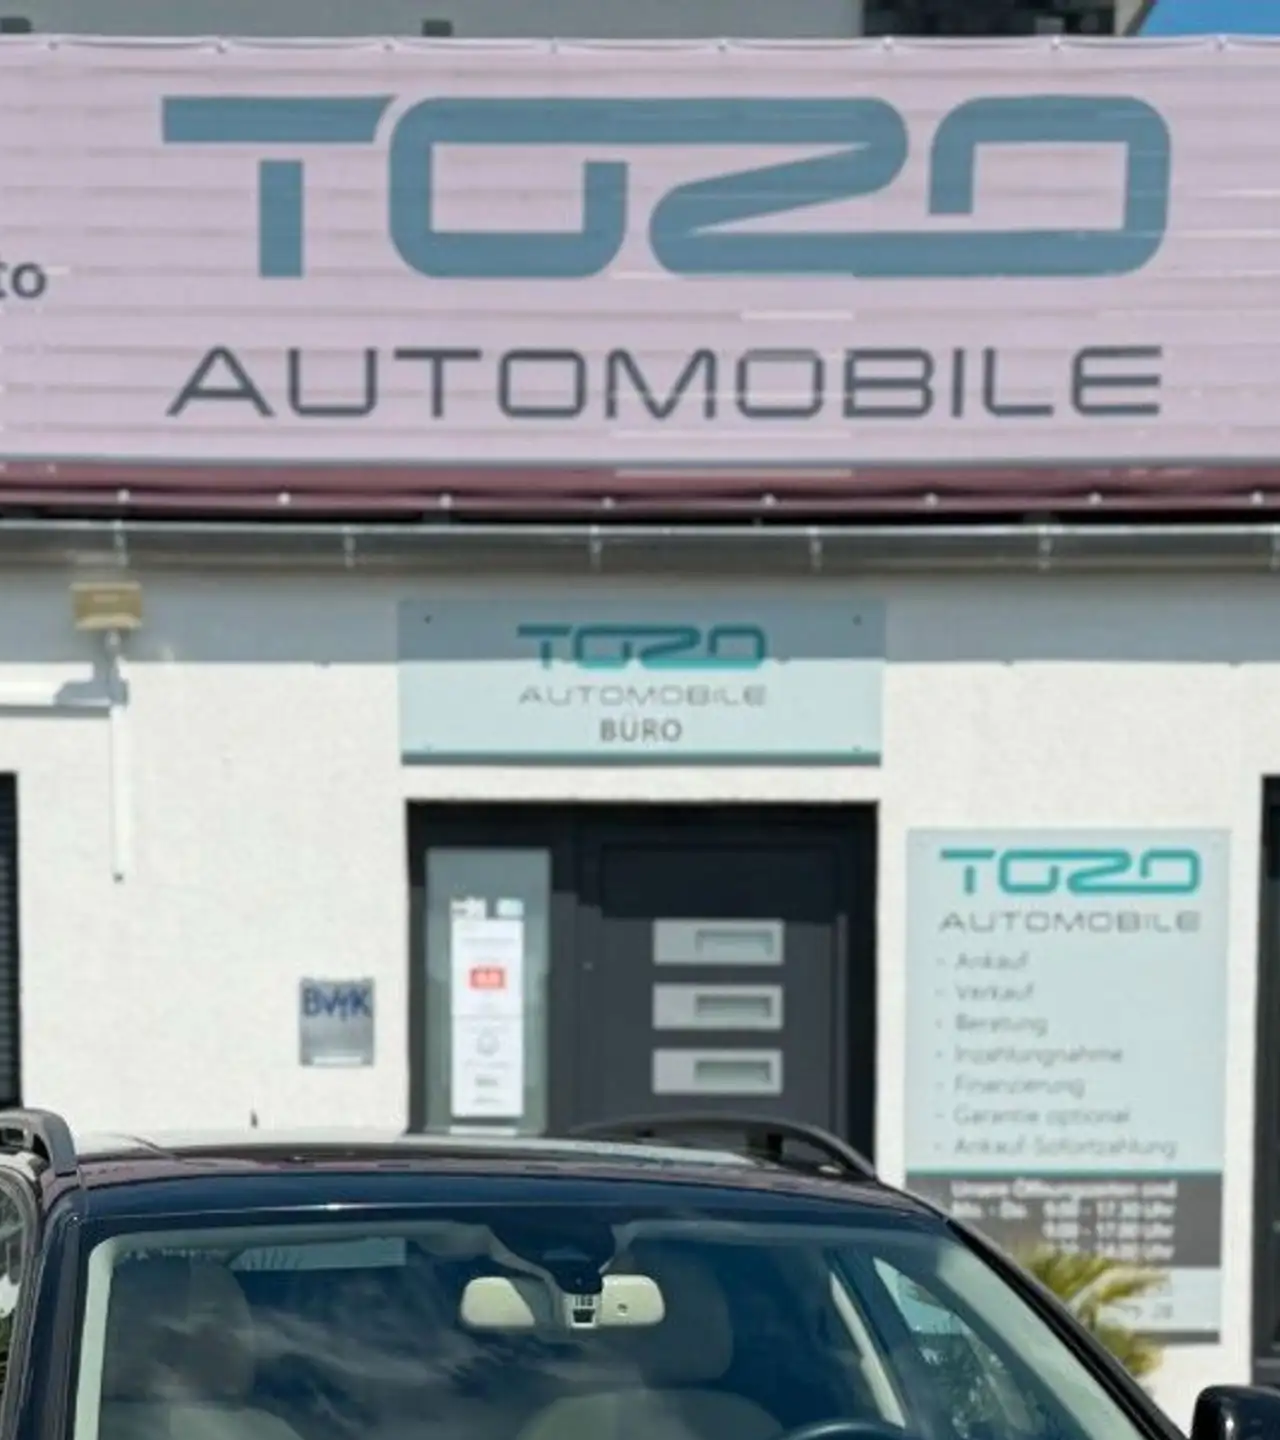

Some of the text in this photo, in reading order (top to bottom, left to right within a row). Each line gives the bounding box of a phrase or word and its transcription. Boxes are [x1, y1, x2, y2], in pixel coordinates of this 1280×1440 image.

[161, 94, 1172, 280] TOZO
[165, 345, 1163, 420] AUTOMOBILE
[516, 622, 769, 671] TOZO
[516, 684, 769, 707] AUTOMOBILE
[939, 848, 1202, 895] TOZO
[938, 911, 1202, 933] AUTOMOBILE
[954, 951, 1029, 970] Ankauf
[954, 982, 1035, 1001] Verkauf
[954, 1012, 1049, 1036] Beratung
[954, 1044, 1124, 1067] Inzahlungnahme
[954, 1073, 1086, 1099] Finanzierung
[952, 1103, 1132, 1126] Garantie optional
